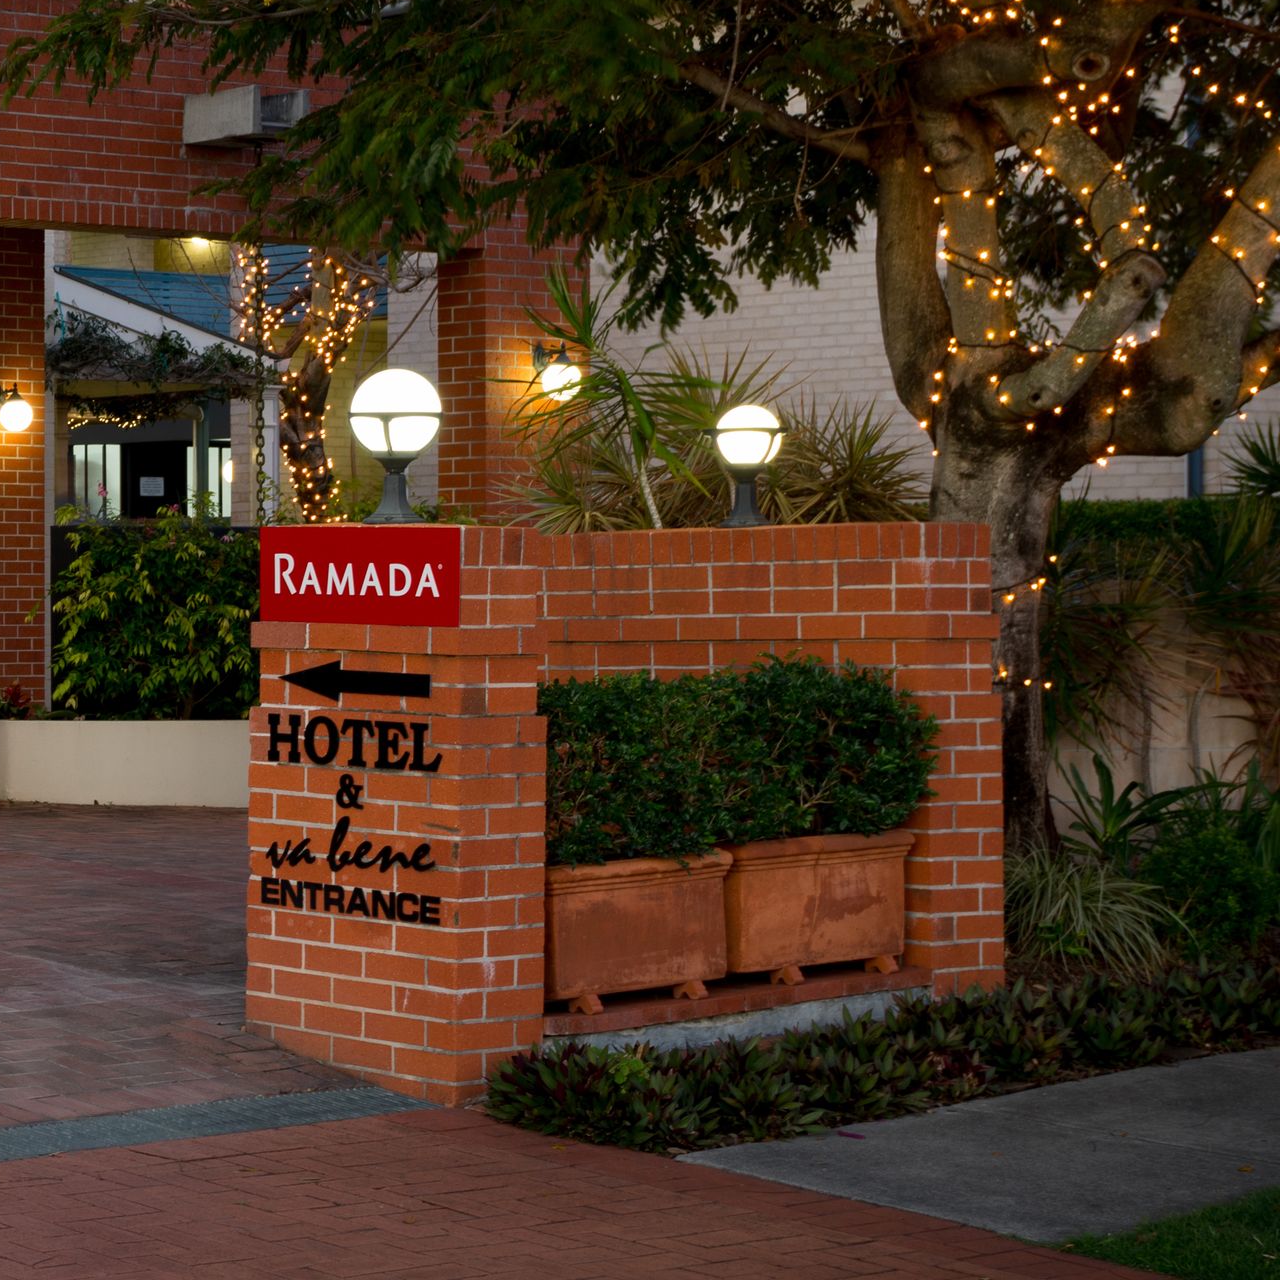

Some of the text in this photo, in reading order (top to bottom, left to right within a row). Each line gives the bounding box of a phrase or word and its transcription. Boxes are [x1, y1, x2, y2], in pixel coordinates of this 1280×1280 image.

[274, 552, 441, 598] RAMADA
[267, 713, 443, 772] HOTEL
[335, 773, 364, 810] &
[265, 815, 436, 873] va bene
[260, 876, 441, 926] ENTRANCE
